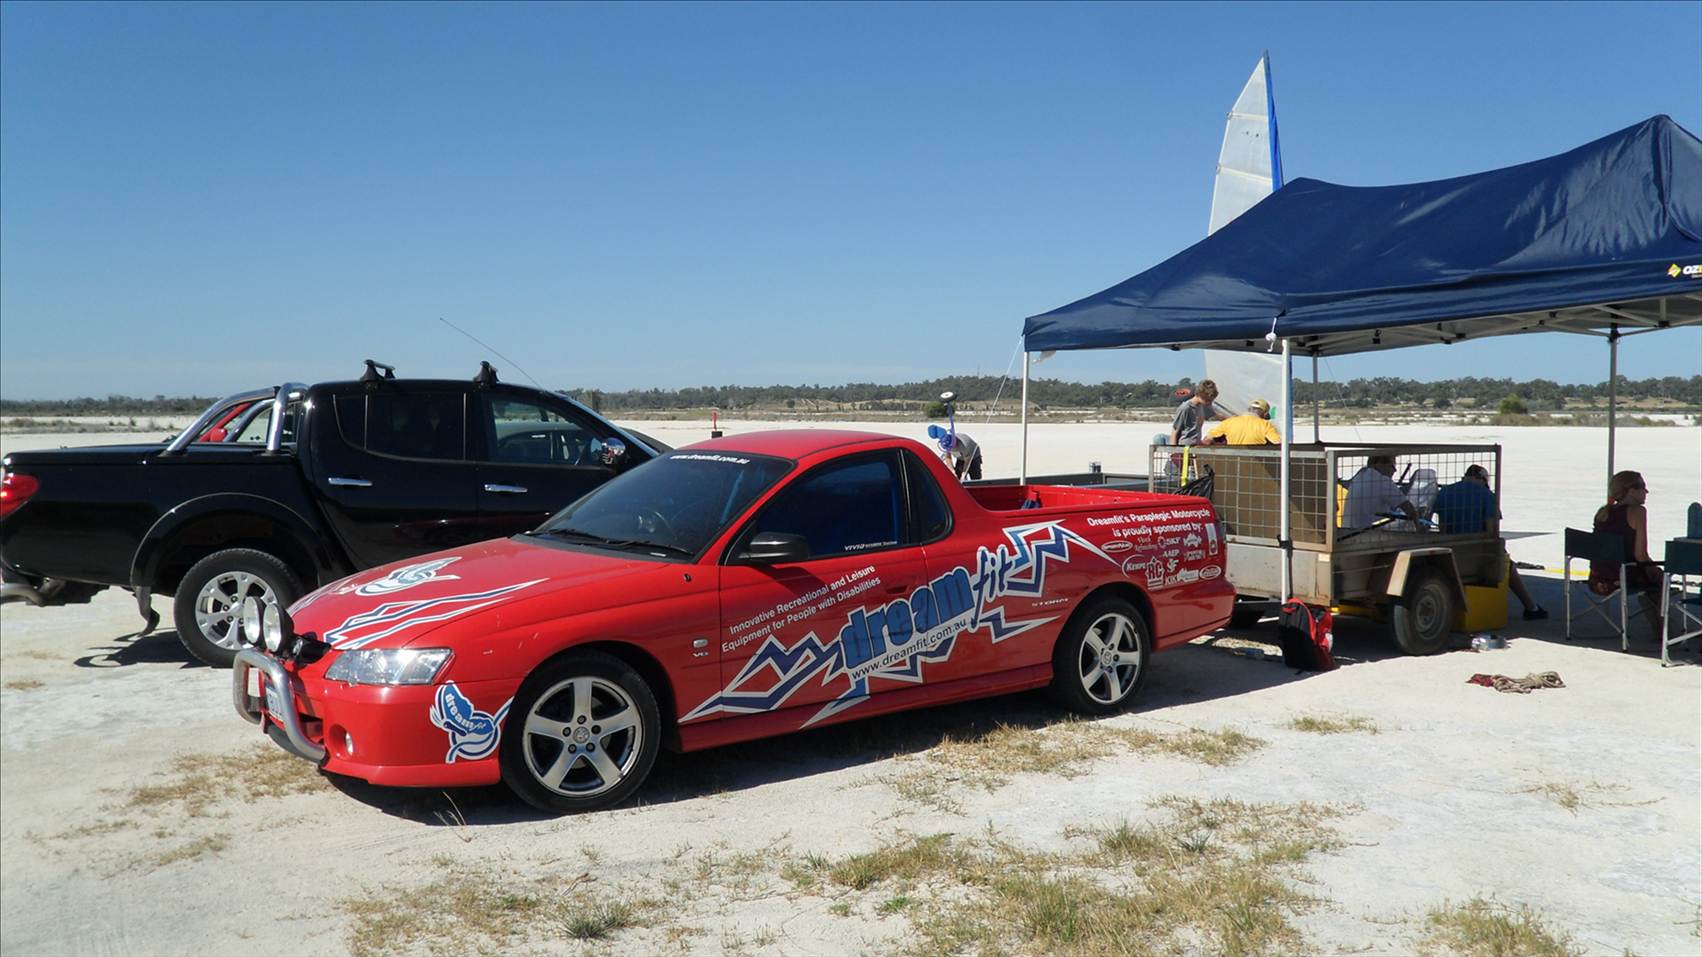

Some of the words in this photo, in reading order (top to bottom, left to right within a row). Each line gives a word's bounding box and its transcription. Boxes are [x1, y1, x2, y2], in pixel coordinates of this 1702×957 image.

[1087, 514, 1130, 527] Dreamfit's
[1130, 511, 1171, 523] Paraplegic
[1171, 508, 1211, 520] Motorcycle
[1122, 524, 1152, 538] proudly
[1153, 522, 1191, 534] sponsored
[721, 625, 772, 653] Equipment
[772, 618, 785, 631] for
[786, 603, 817, 623] People
[818, 595, 837, 611] with
[837, 576, 881, 602] Disabilities
[729, 608, 775, 635] Innovative
[776, 585, 830, 615] Recreational
[830, 577, 846, 591] and
[846, 564, 876, 583] Leisure
[852, 617, 967, 680] www.dreamfit.com.au
